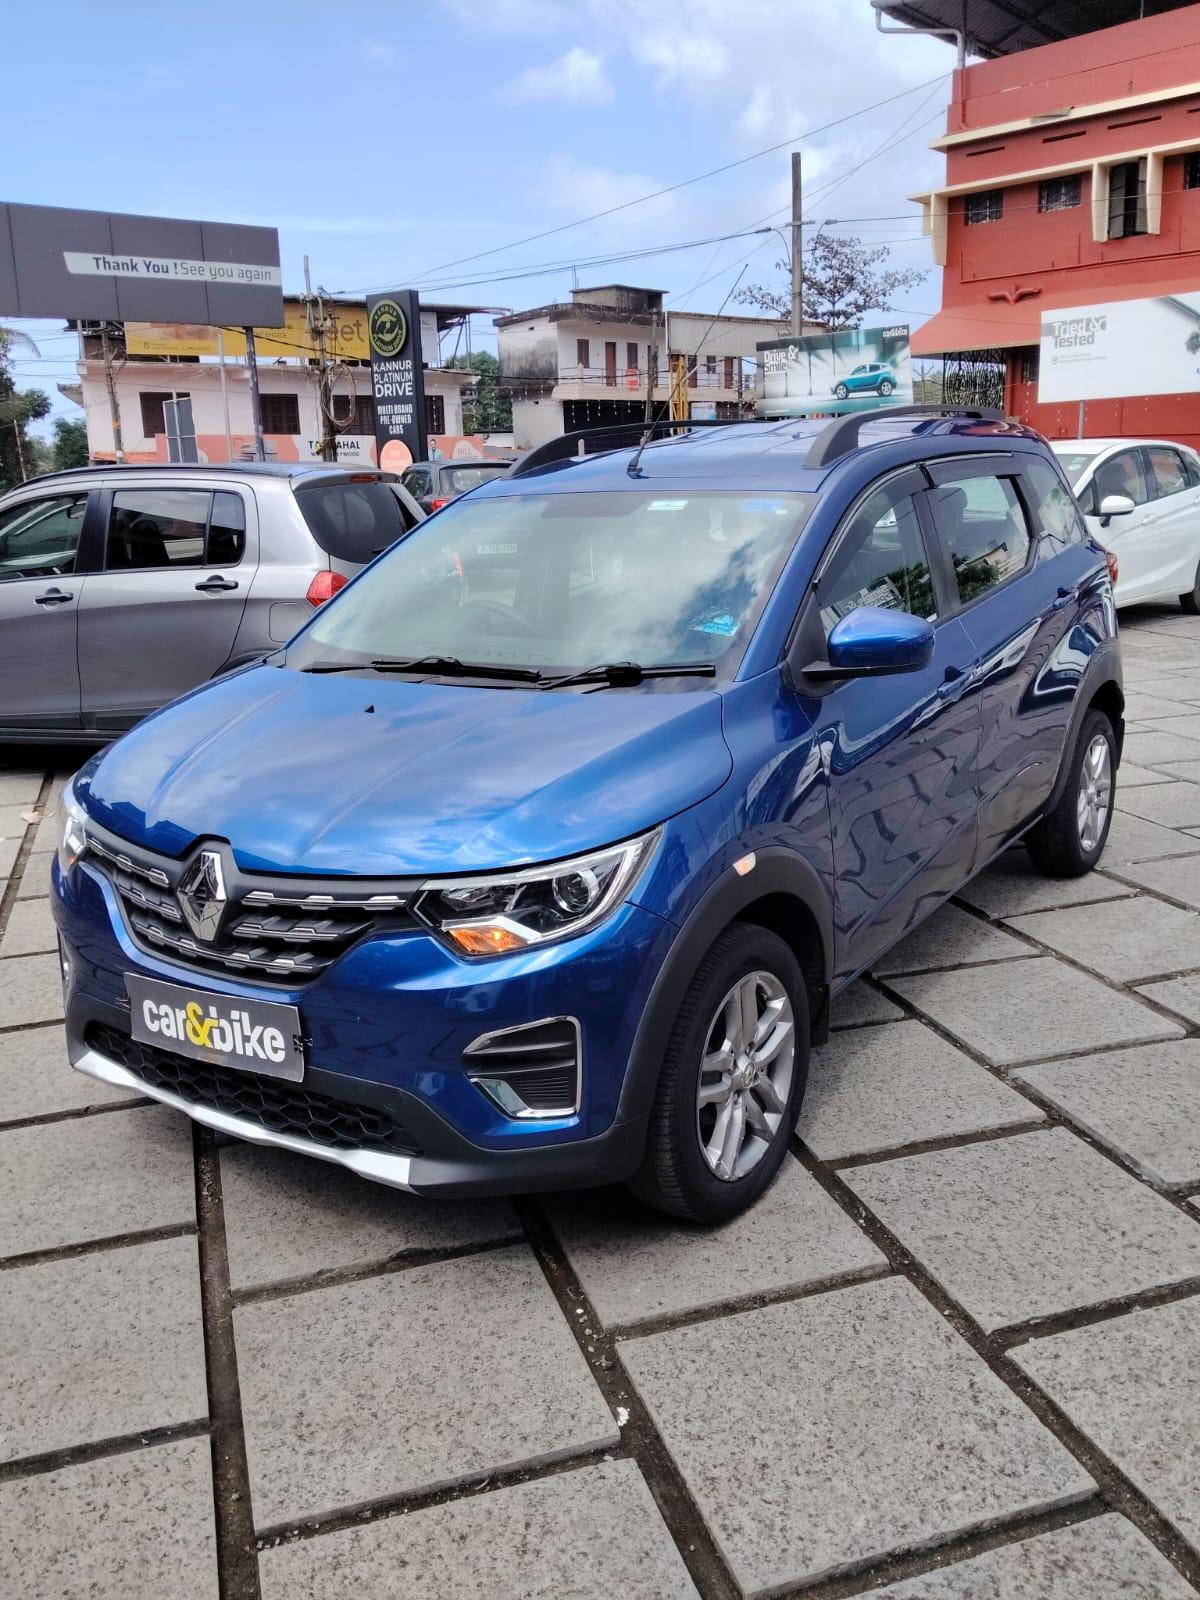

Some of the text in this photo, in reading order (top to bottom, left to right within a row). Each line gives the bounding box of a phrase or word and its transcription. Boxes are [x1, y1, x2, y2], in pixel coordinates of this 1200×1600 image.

[93, 257, 139, 272] Thank
[143, 261, 169, 274] You
[180, 262, 206, 276] See
[209, 267, 234, 280] you
[237, 266, 272, 282] again
[1053, 316, 1107, 338] Tried &
[1052, 331, 1095, 349] Tested
[763, 345, 799, 363] Drive &
[373, 360, 412, 372] KANNUR
[764, 361, 788, 374] Smile
[374, 371, 413, 384] PLATINUM
[375, 383, 414, 398] DRIVE
[394, 403, 413, 415] BRAND
[389, 424, 404, 435] CARS
[142, 999, 286, 1063] car&bike
